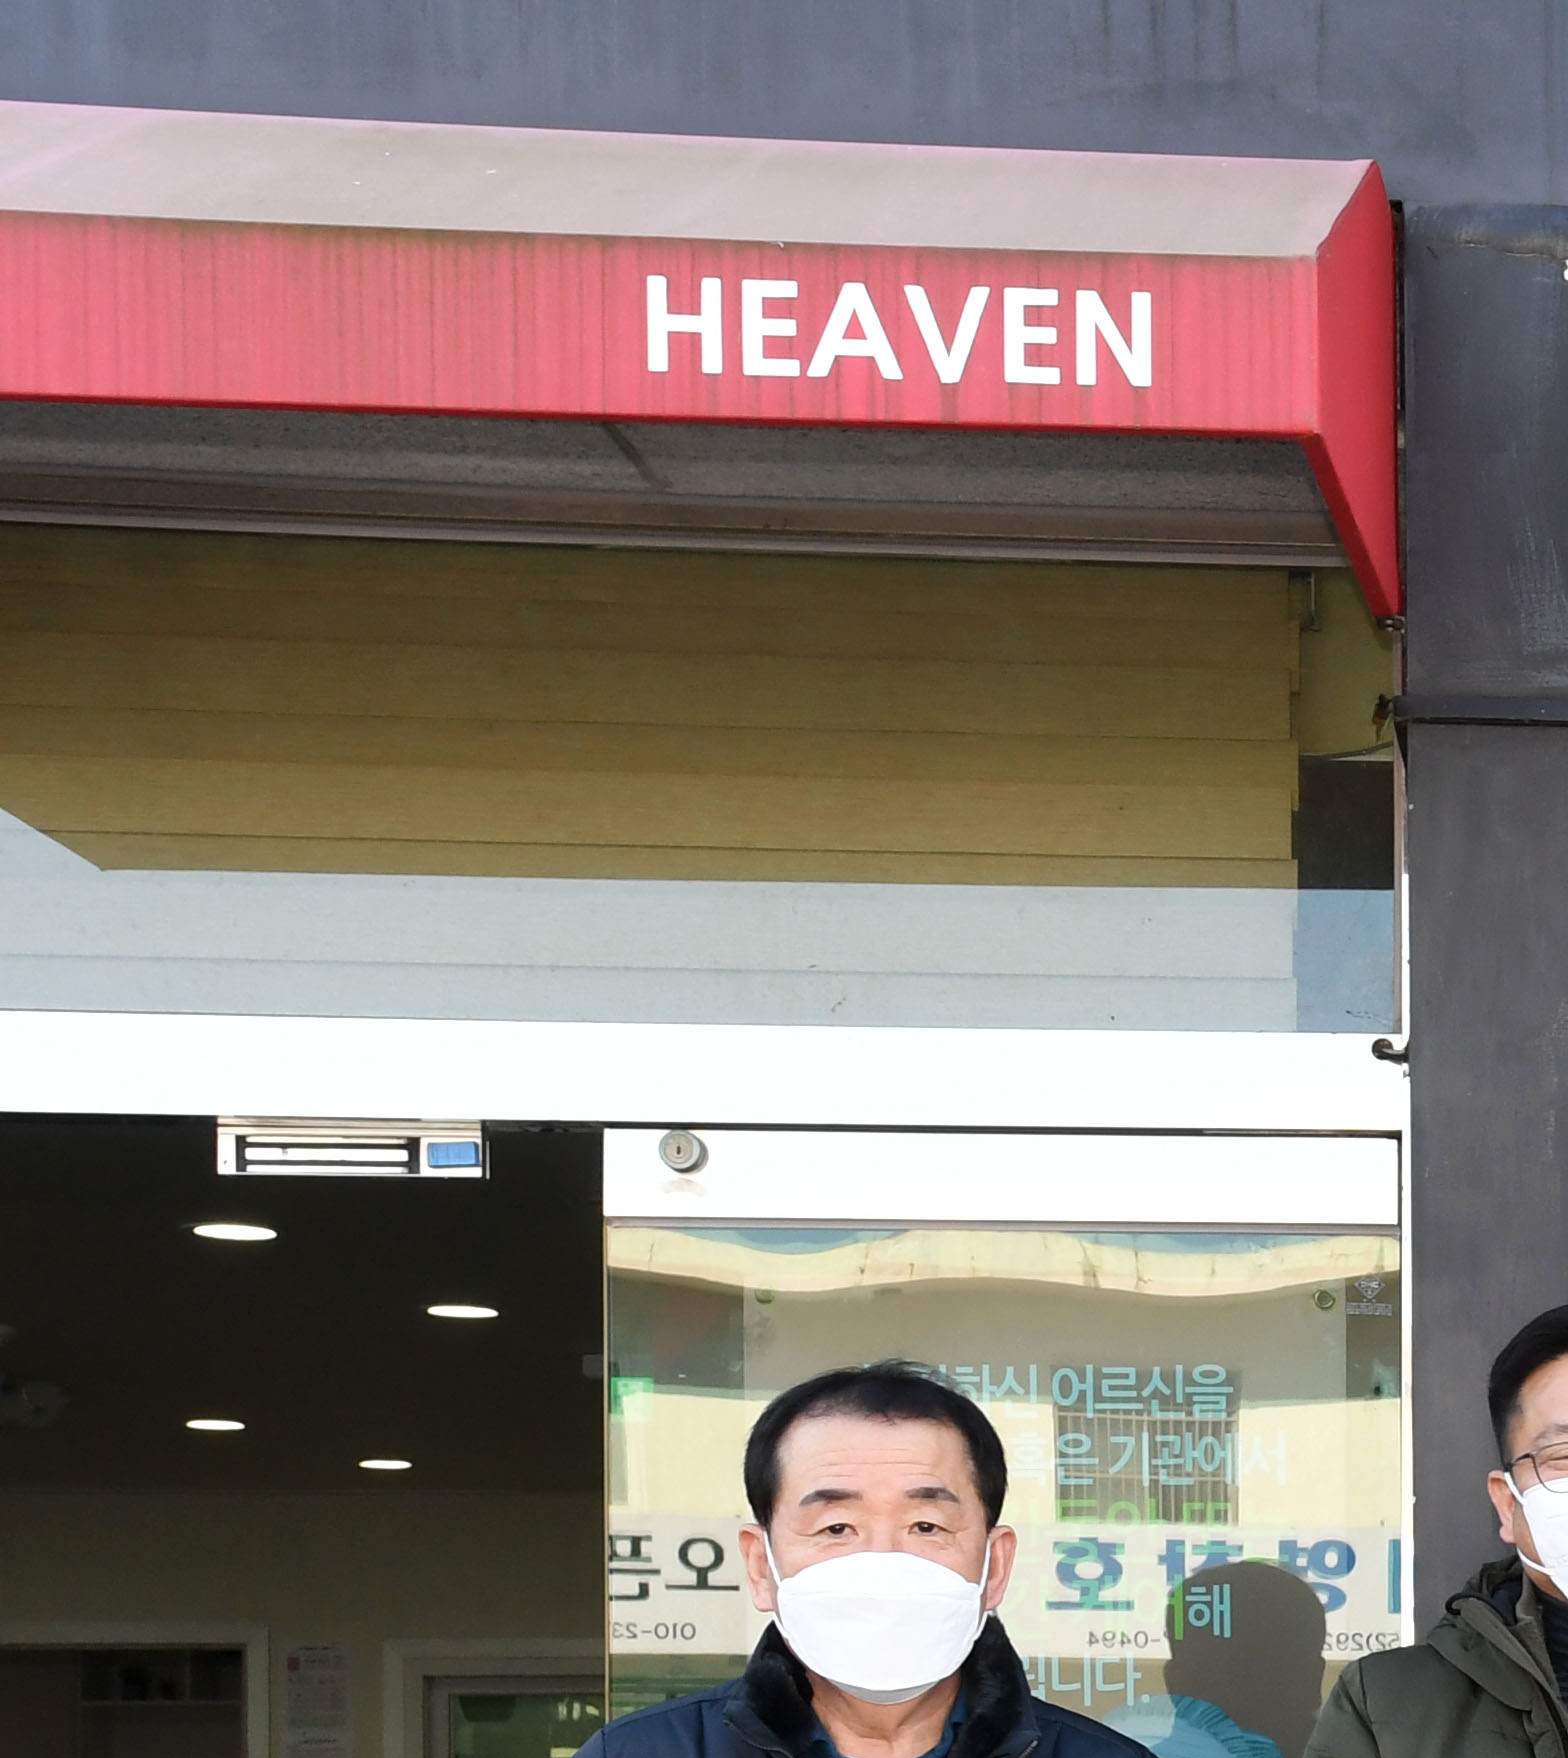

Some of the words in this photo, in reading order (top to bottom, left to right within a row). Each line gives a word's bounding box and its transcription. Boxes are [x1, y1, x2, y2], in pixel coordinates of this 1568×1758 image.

[645, 274, 1153, 388] HEAVEN
[1051, 1364, 1234, 1420] 어르신을
[1108, 1431, 1288, 1487] 기관에서
